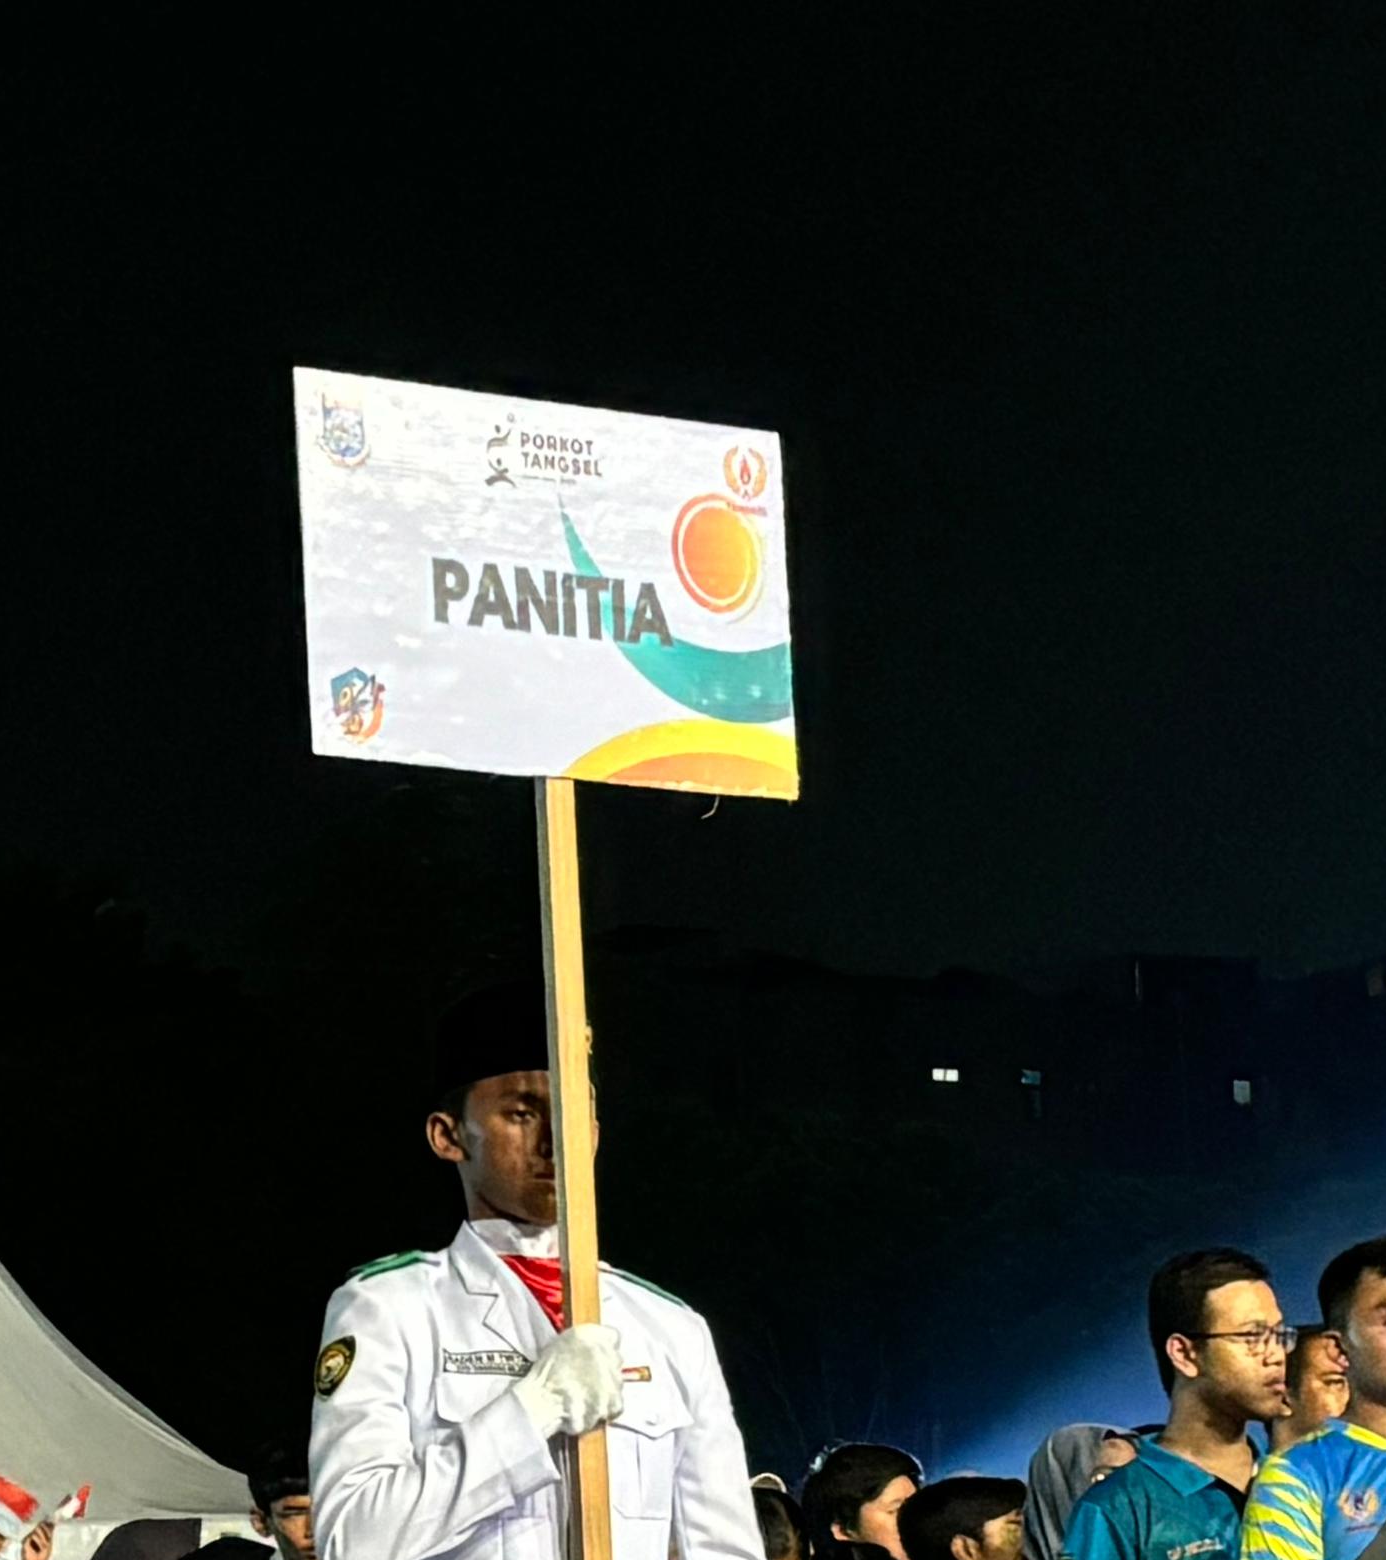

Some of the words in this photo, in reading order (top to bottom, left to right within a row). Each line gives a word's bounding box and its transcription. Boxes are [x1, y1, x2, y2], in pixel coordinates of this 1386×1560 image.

[520, 431, 594, 456] PORKOT
[520, 451, 602, 477] TANGSEL
[431, 556, 674, 647] PANITIA
